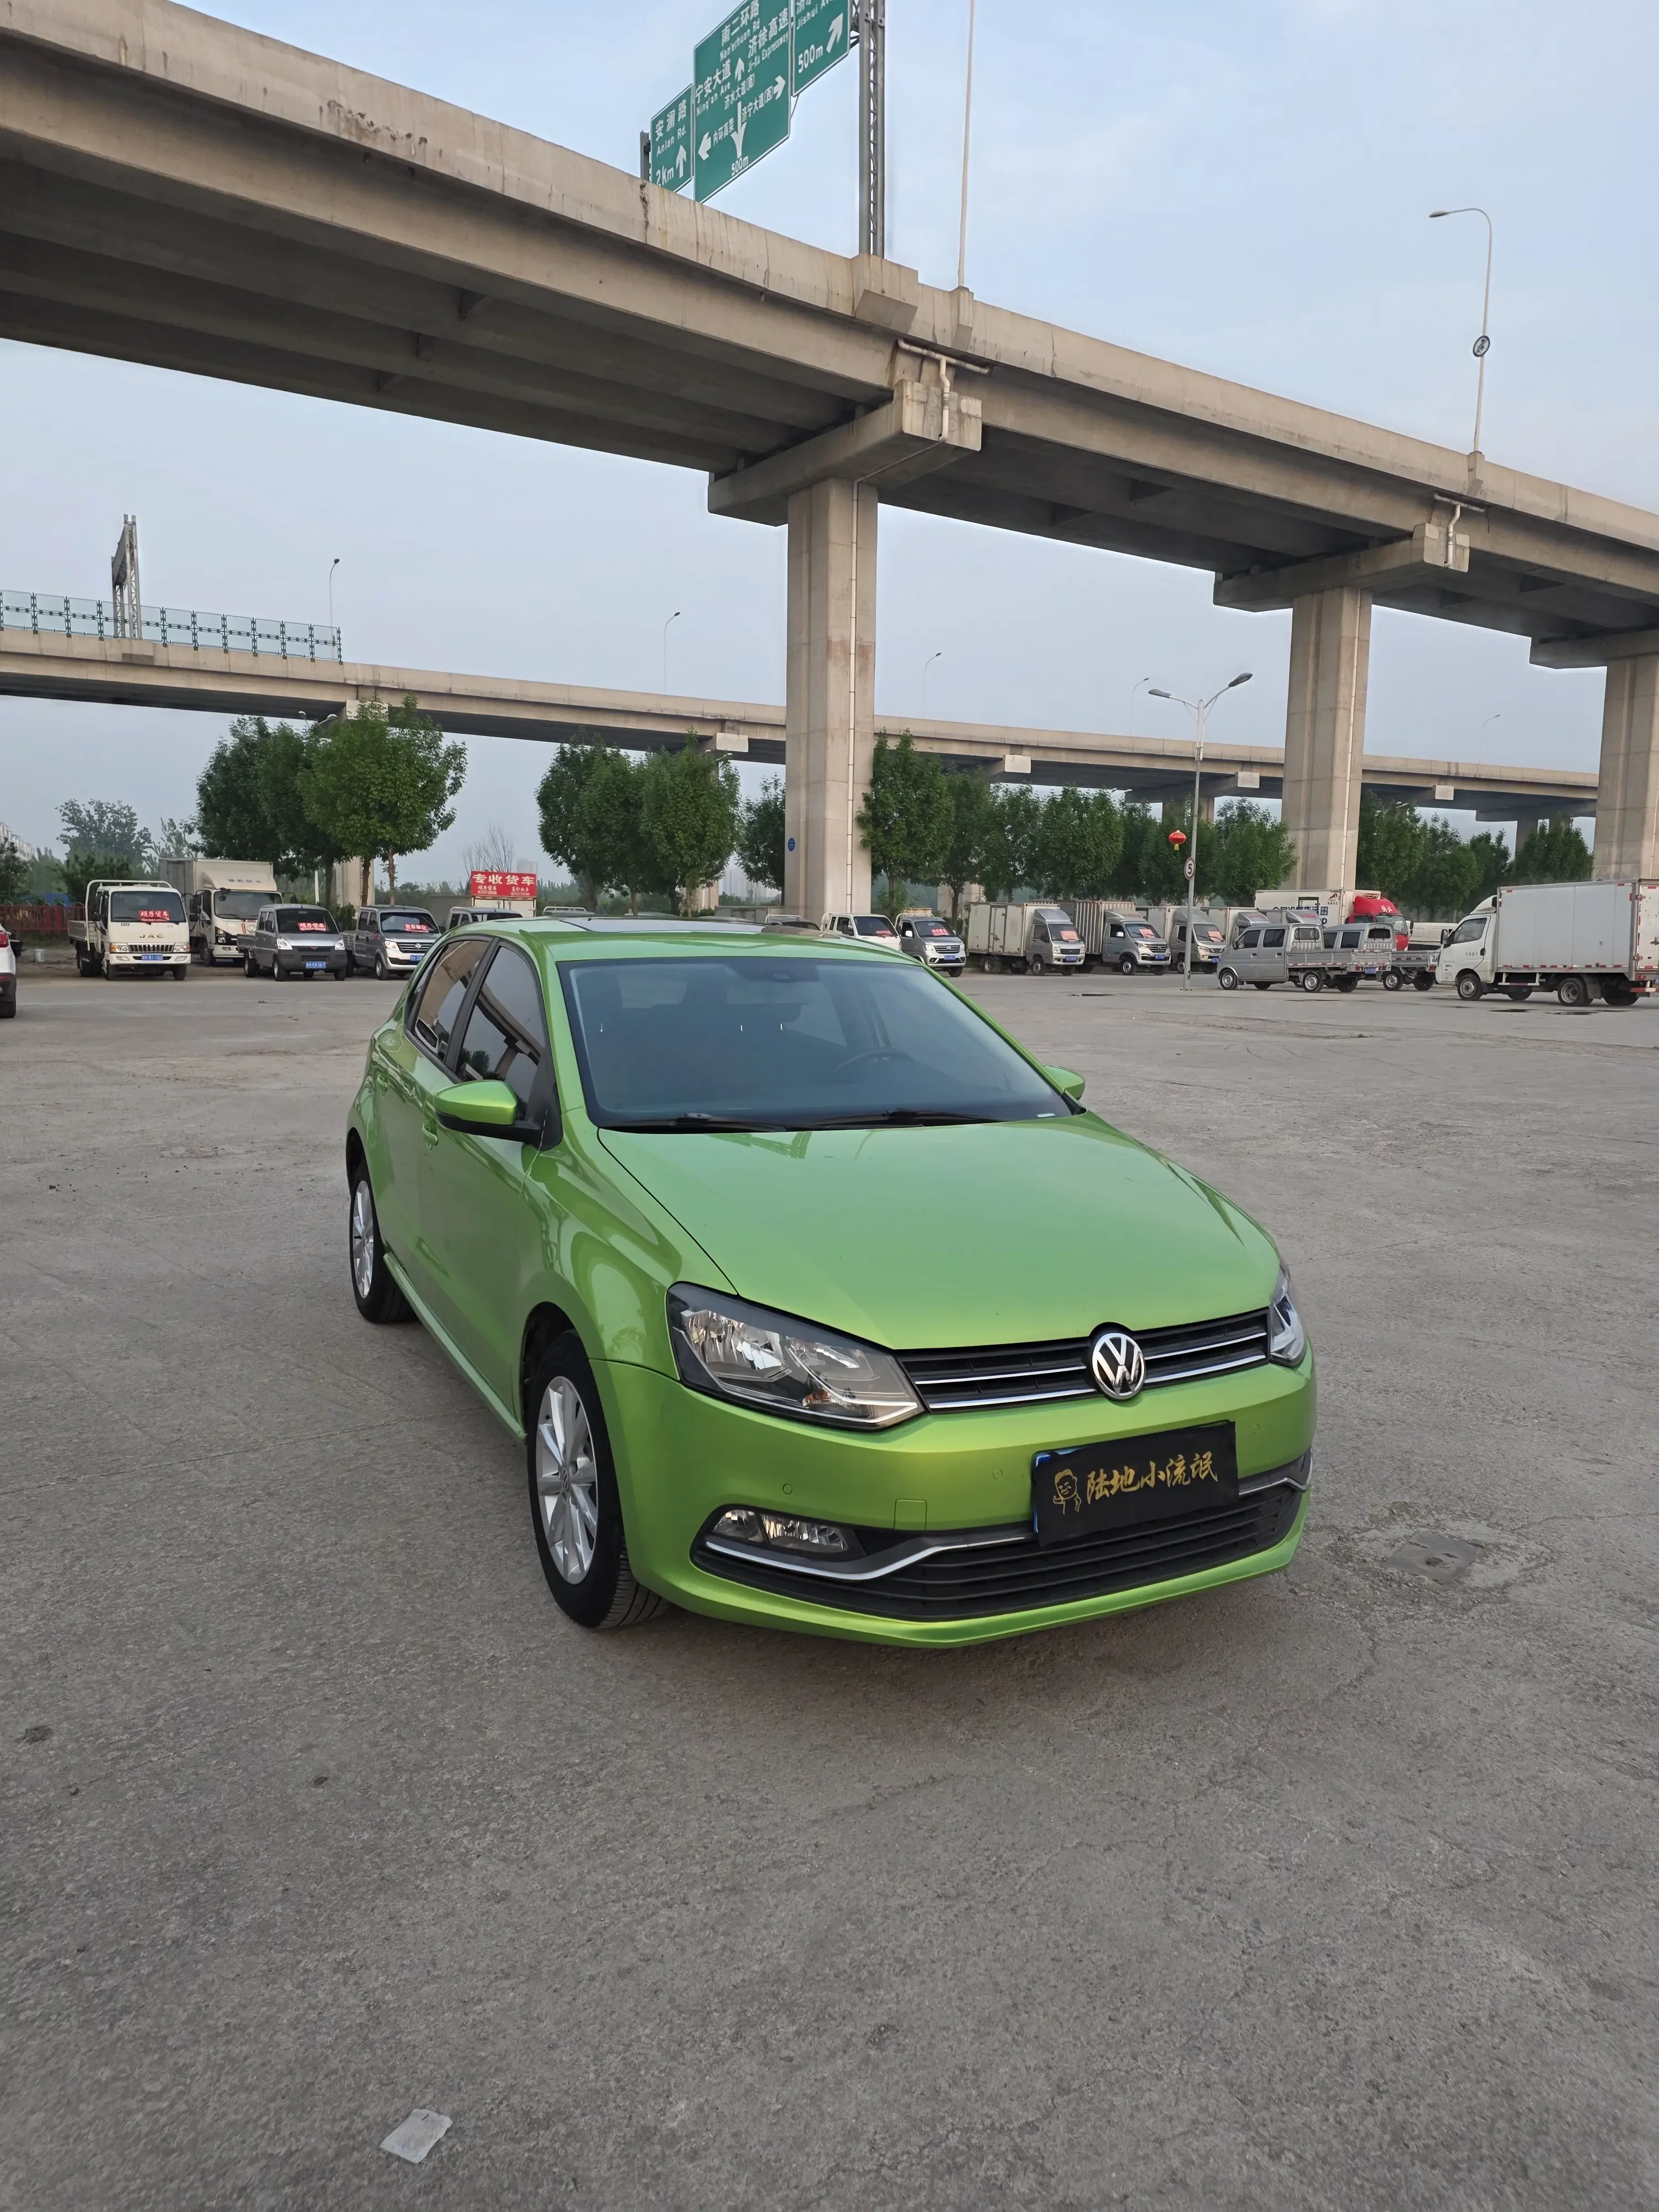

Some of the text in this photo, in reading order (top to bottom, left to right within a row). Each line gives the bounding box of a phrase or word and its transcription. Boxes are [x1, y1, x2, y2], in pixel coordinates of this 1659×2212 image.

[721, 0, 759, 46] 南二环路
[796, 3, 818, 30] Jishui
[748, 8, 788, 59] 济徐高速
[798, 44, 823, 73] 500m
[695, 58, 731, 104] 宁安大道
[720, 82, 731, 96] Ave
[655, 99, 687, 142] 安澜路
[713, 117, 734, 146] 内环高架
[656, 136, 675, 157] Anlan
[656, 165, 674, 186] 2Km
[731, 155, 749, 176] 500m
[473, 873, 535, 886] 专收货车
[1188, 864, 1192, 874] 5
[1087, 1451, 1218, 1505] 陆地小流氓
